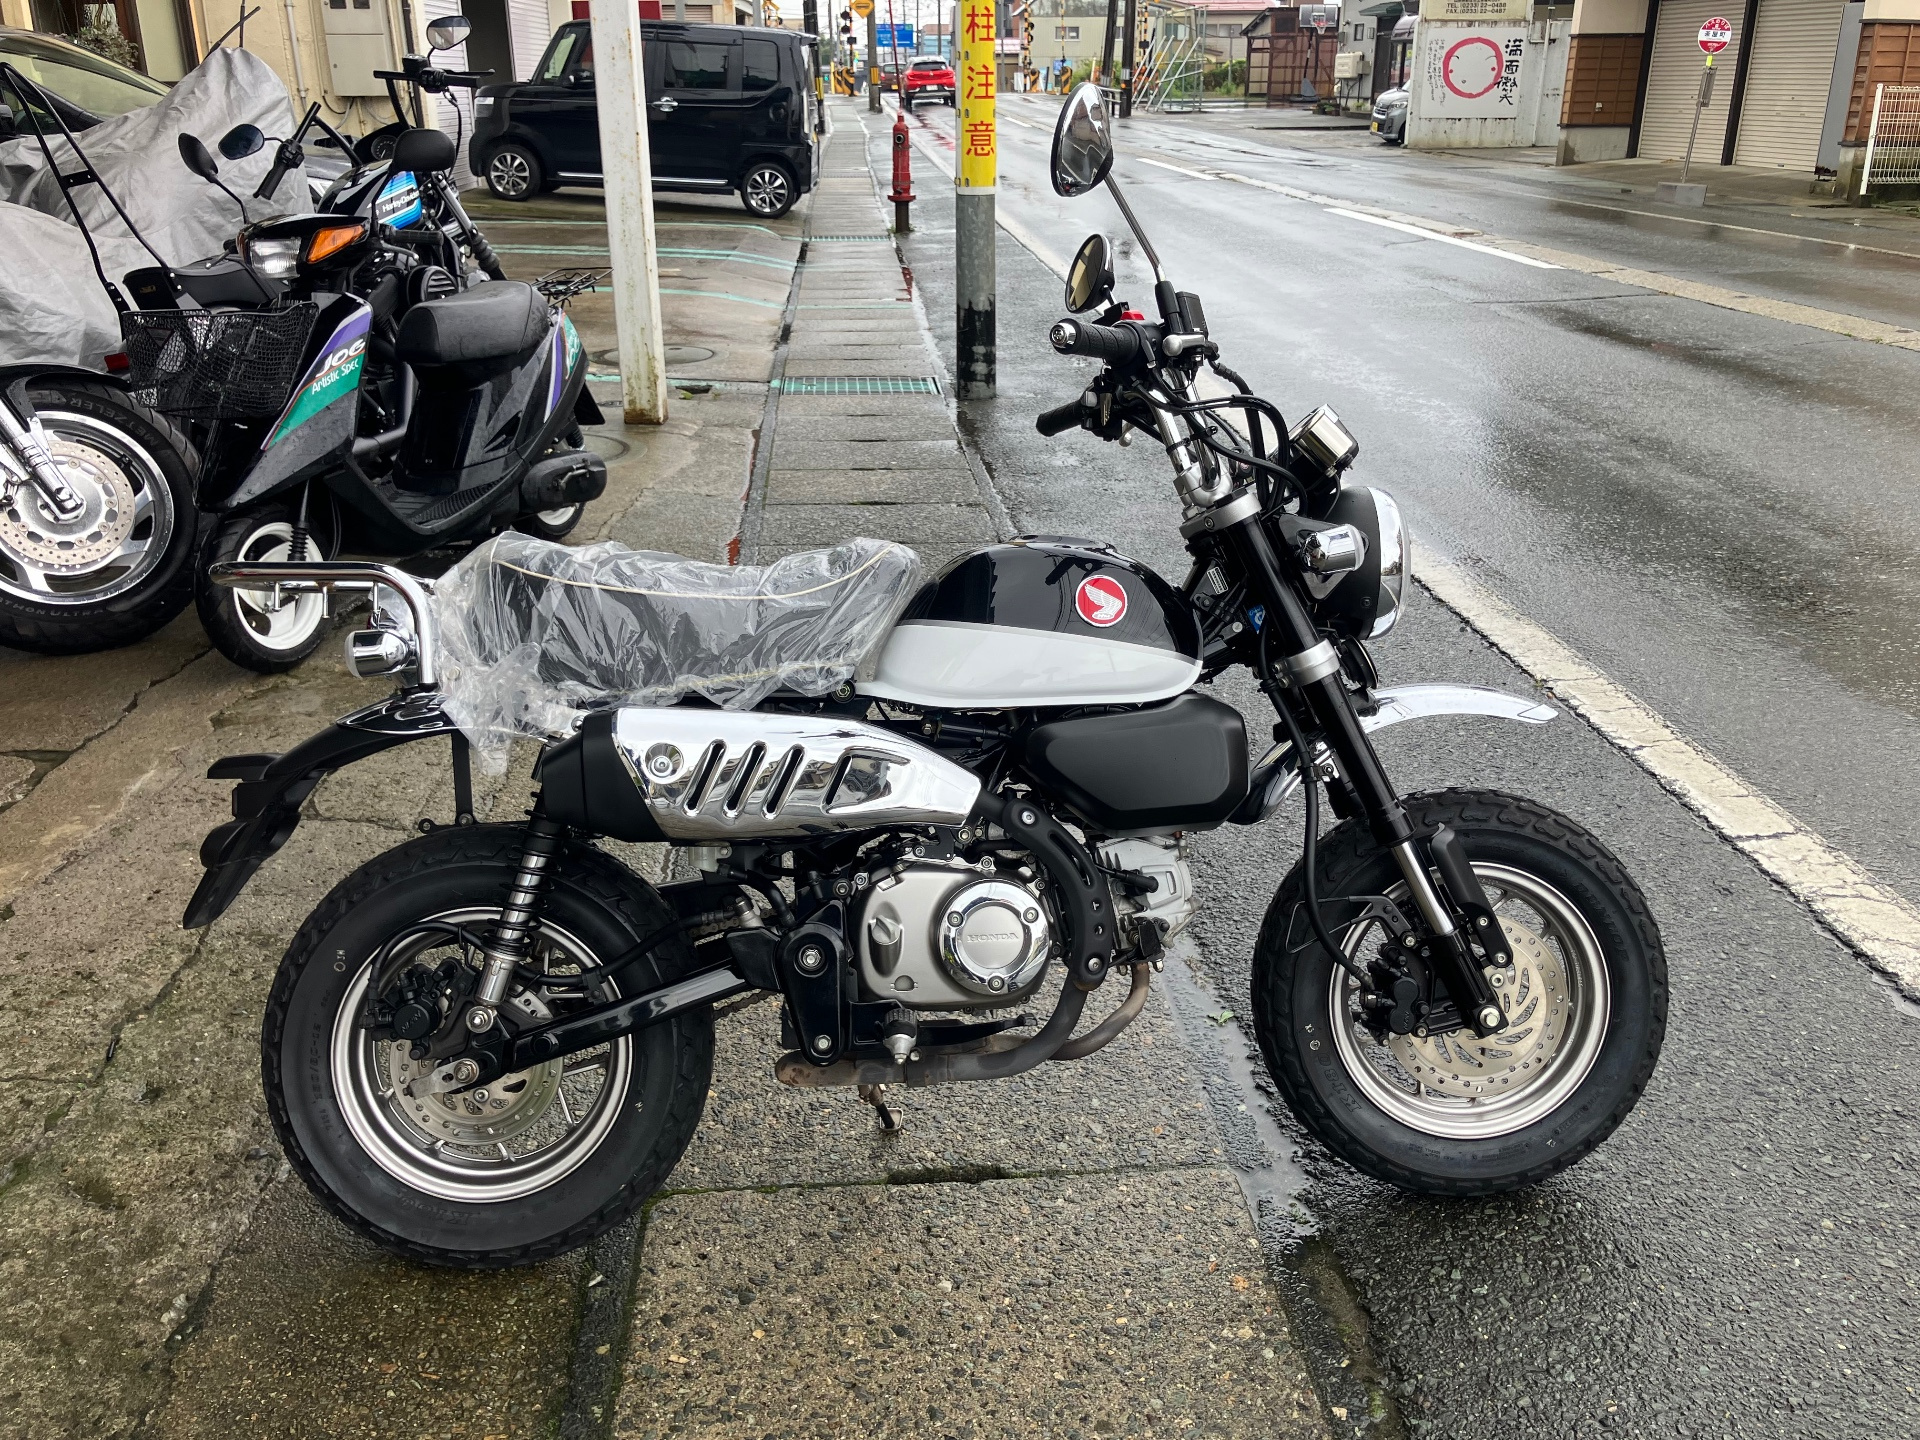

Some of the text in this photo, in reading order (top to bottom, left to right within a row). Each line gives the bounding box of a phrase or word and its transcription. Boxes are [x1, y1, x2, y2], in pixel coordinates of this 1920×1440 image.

[965, 5, 995, 157] 柱注意
[315, 338, 366, 378] JOG
[311, 370, 340, 396] Artistic
[69, 397, 159, 446] METZELER
[967, 932, 1019, 943] HONDA
